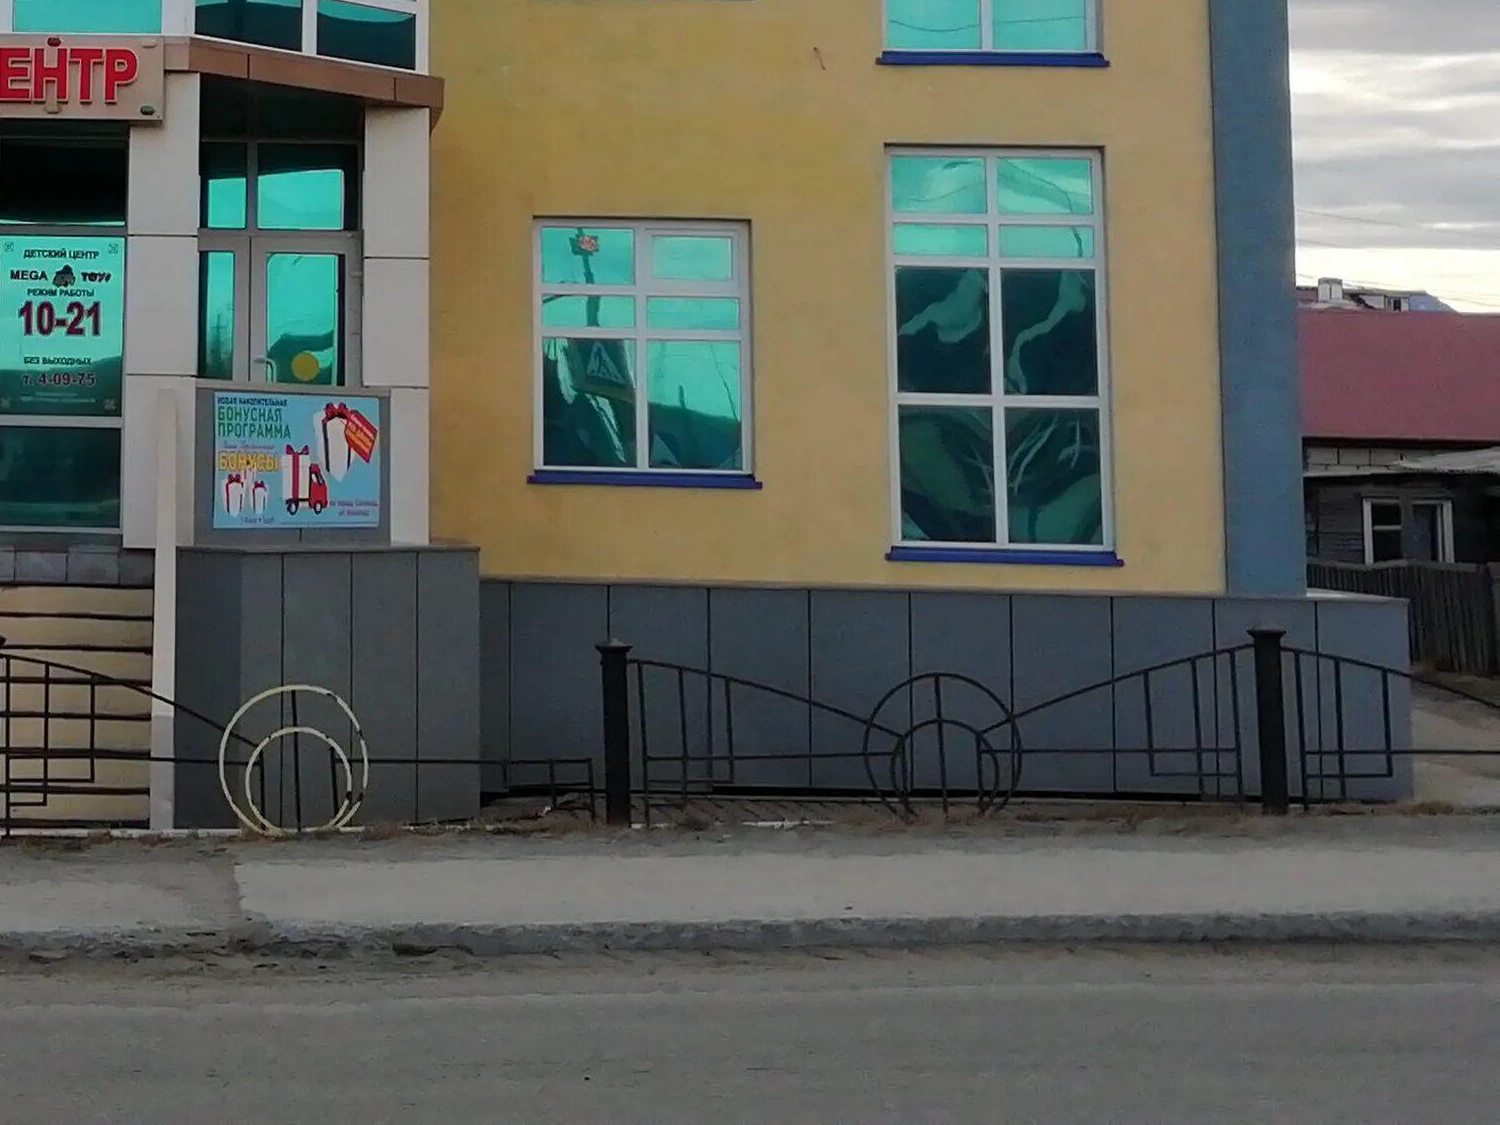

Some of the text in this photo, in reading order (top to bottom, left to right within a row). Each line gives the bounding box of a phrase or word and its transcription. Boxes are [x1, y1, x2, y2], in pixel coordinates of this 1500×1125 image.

[23, 248, 100, 260] ДЕТСКИЙ ЦЕНТР
[10, 270, 49, 282] MEGA
[27, 289, 94, 297] РЕЖИМ РАБОТЫ
[18, 300, 102, 337] 10-21
[24, 357, 92, 365] БЕЗ ВЫХОДНЫХ
[38, 372, 96, 386] 4-09-75
[218, 406, 283, 423] БОНУСНАЯ
[218, 422, 291, 440] ПРОГРАММА
[218, 452, 278, 471] БОНУСЫ
